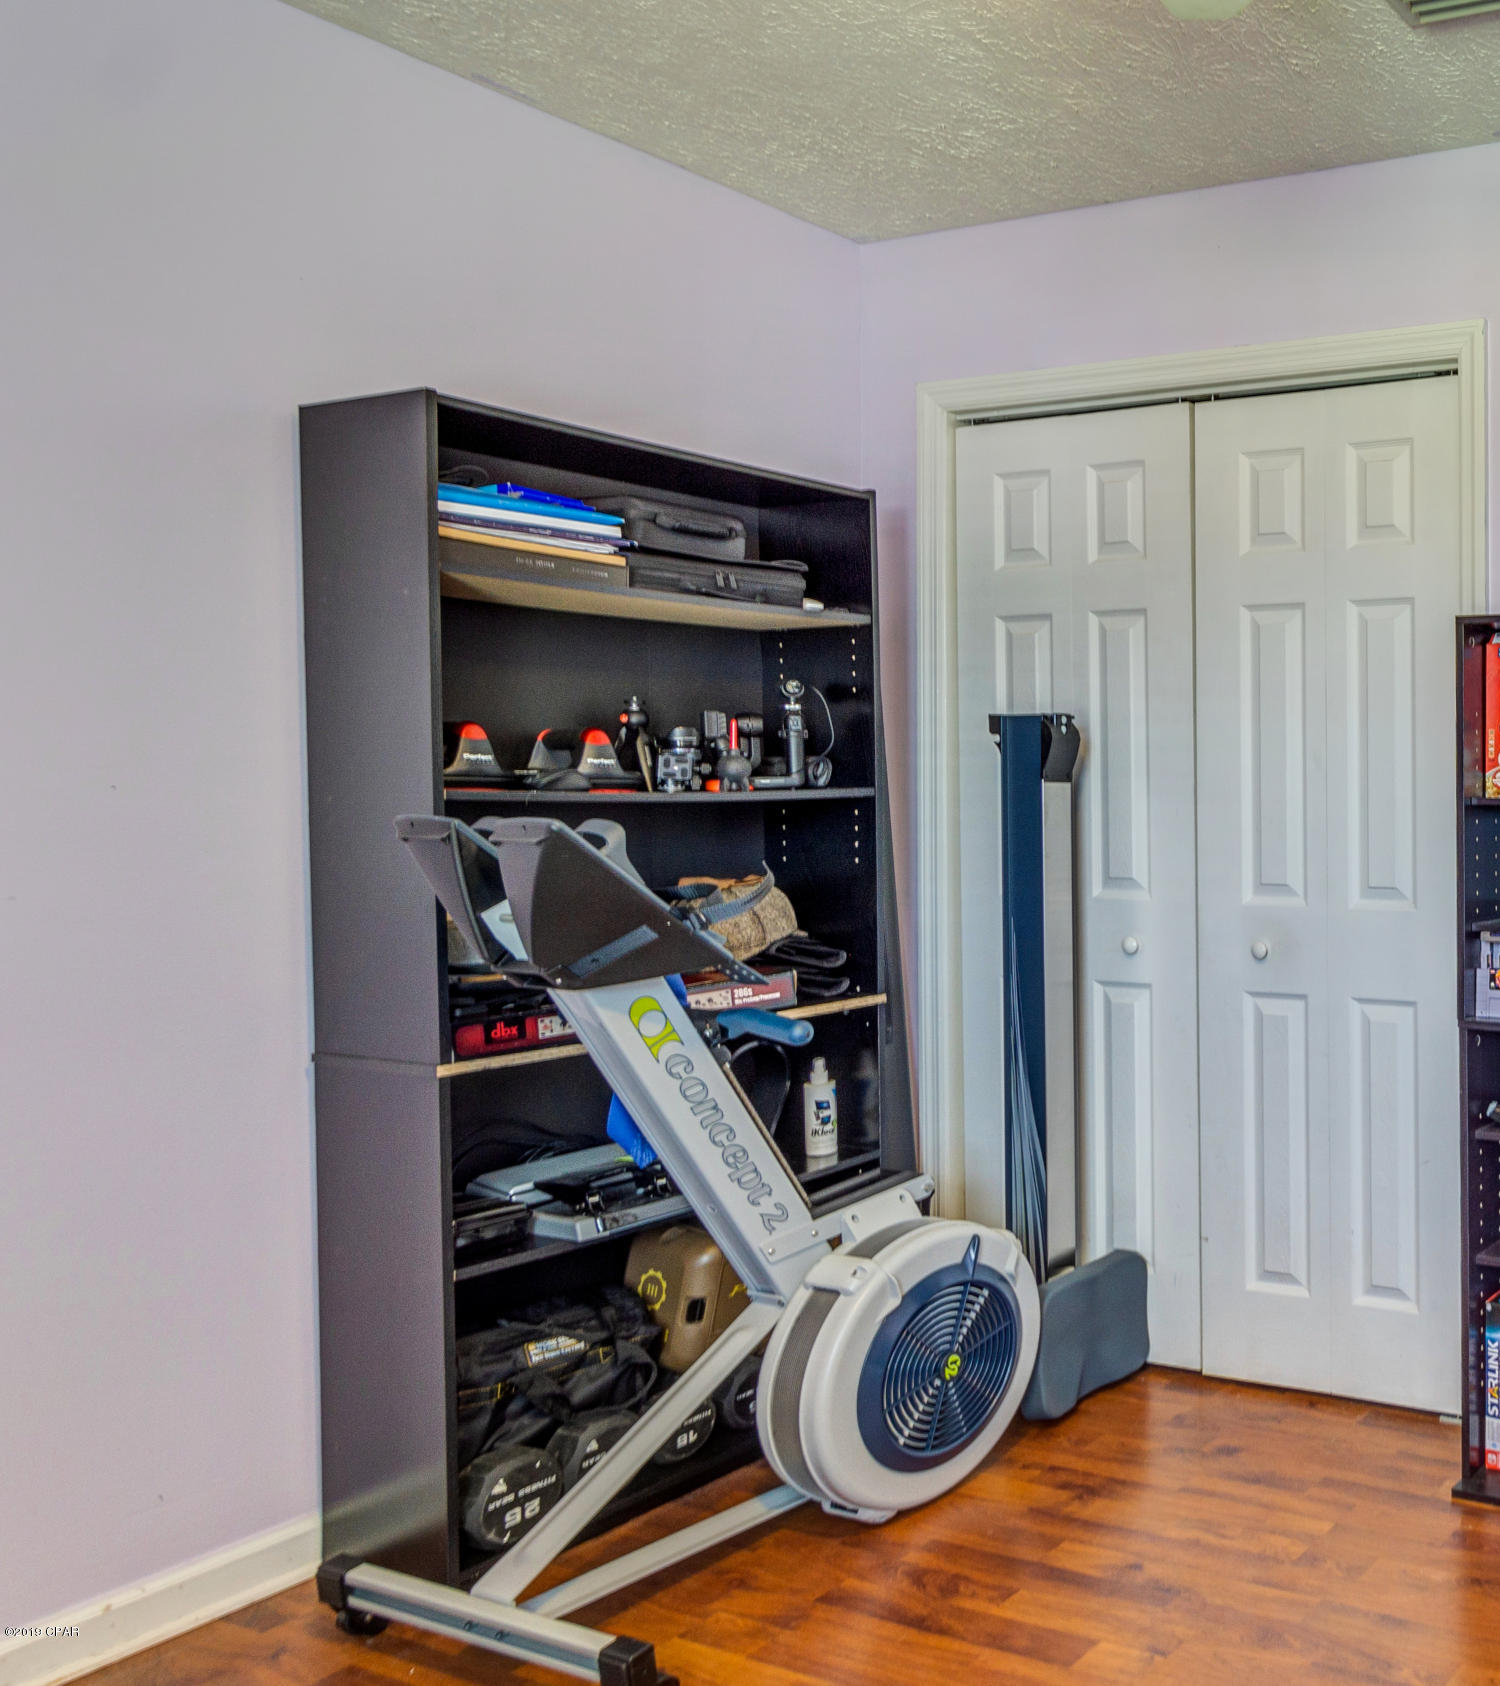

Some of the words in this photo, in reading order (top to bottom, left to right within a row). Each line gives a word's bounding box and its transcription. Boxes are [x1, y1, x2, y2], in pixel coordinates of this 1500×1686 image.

[463, 752, 493, 760] Perfect
[587, 757, 616, 765] Perfect
[490, 1020, 519, 1039] dbx
[665, 1053, 773, 1208] concept
[759, 1202, 789, 1235] 2
[1487, 1339, 1499, 1417] STARLINK
[518, 1473, 557, 1498] FITNESS
[487, 1492, 515, 1512] GEAR
[504, 1496, 541, 1530] 25
